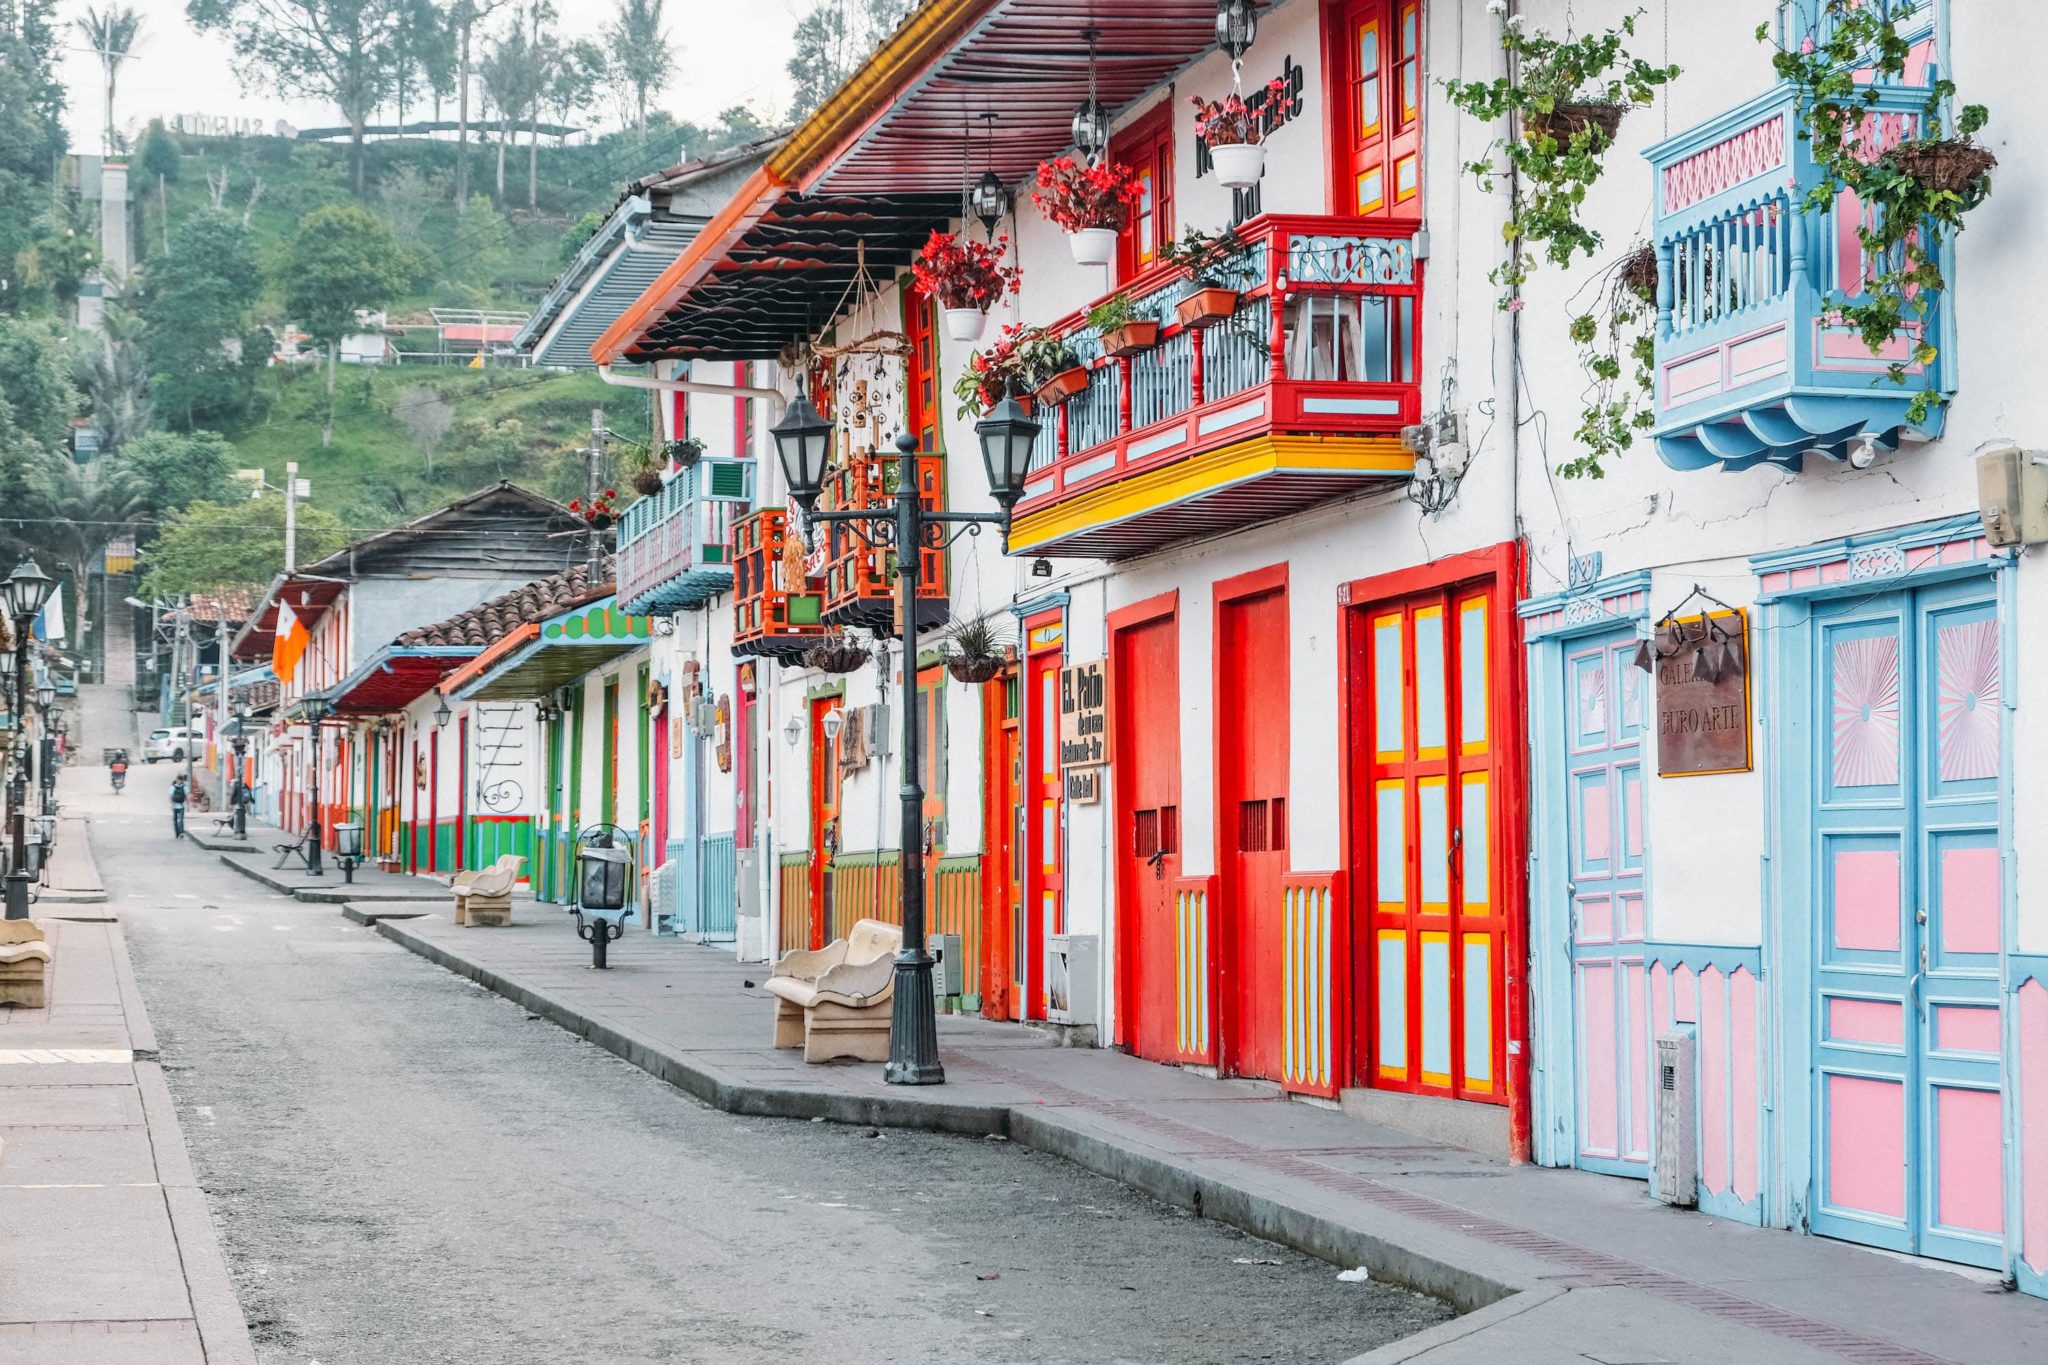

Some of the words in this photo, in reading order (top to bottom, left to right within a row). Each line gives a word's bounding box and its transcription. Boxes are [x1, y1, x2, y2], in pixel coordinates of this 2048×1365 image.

[1077, 664, 1103, 711] Patio
[1661, 708, 1699, 735] PURO
[1702, 705, 1740, 732] ARTE
